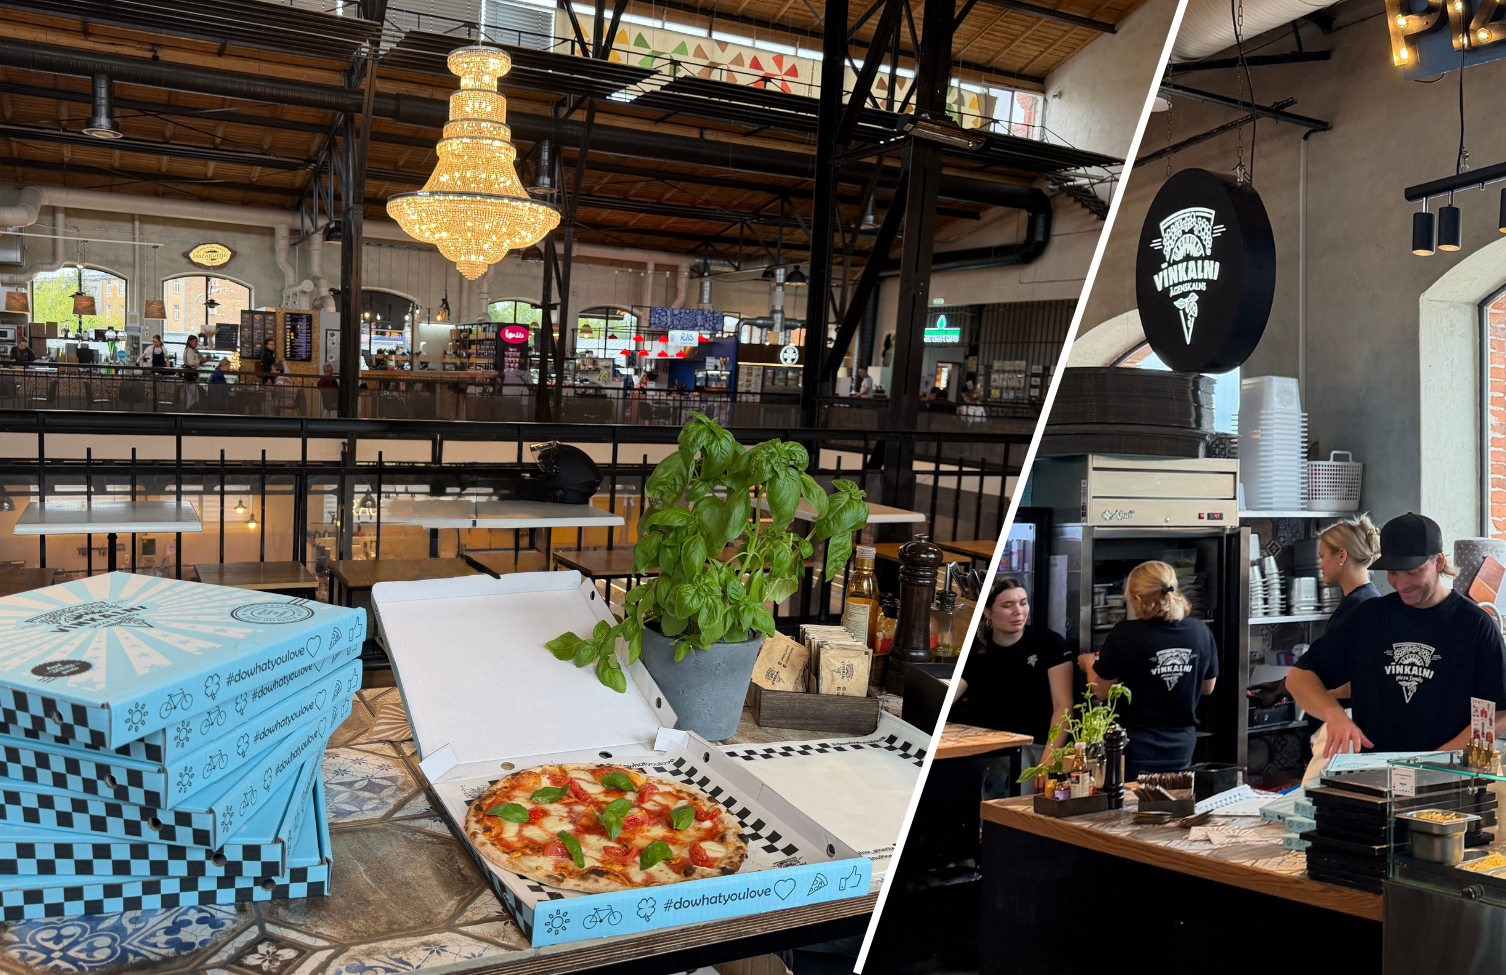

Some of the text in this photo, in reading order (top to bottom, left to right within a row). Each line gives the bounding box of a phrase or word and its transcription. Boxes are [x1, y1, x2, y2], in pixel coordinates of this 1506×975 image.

[226, 646, 306, 687] #dowhatyoulove
[253, 701, 314, 745] #dowhatyoulove
[275, 729, 318, 777] #dowhatyoulove
[664, 887, 772, 913] #dowhatyoulove
